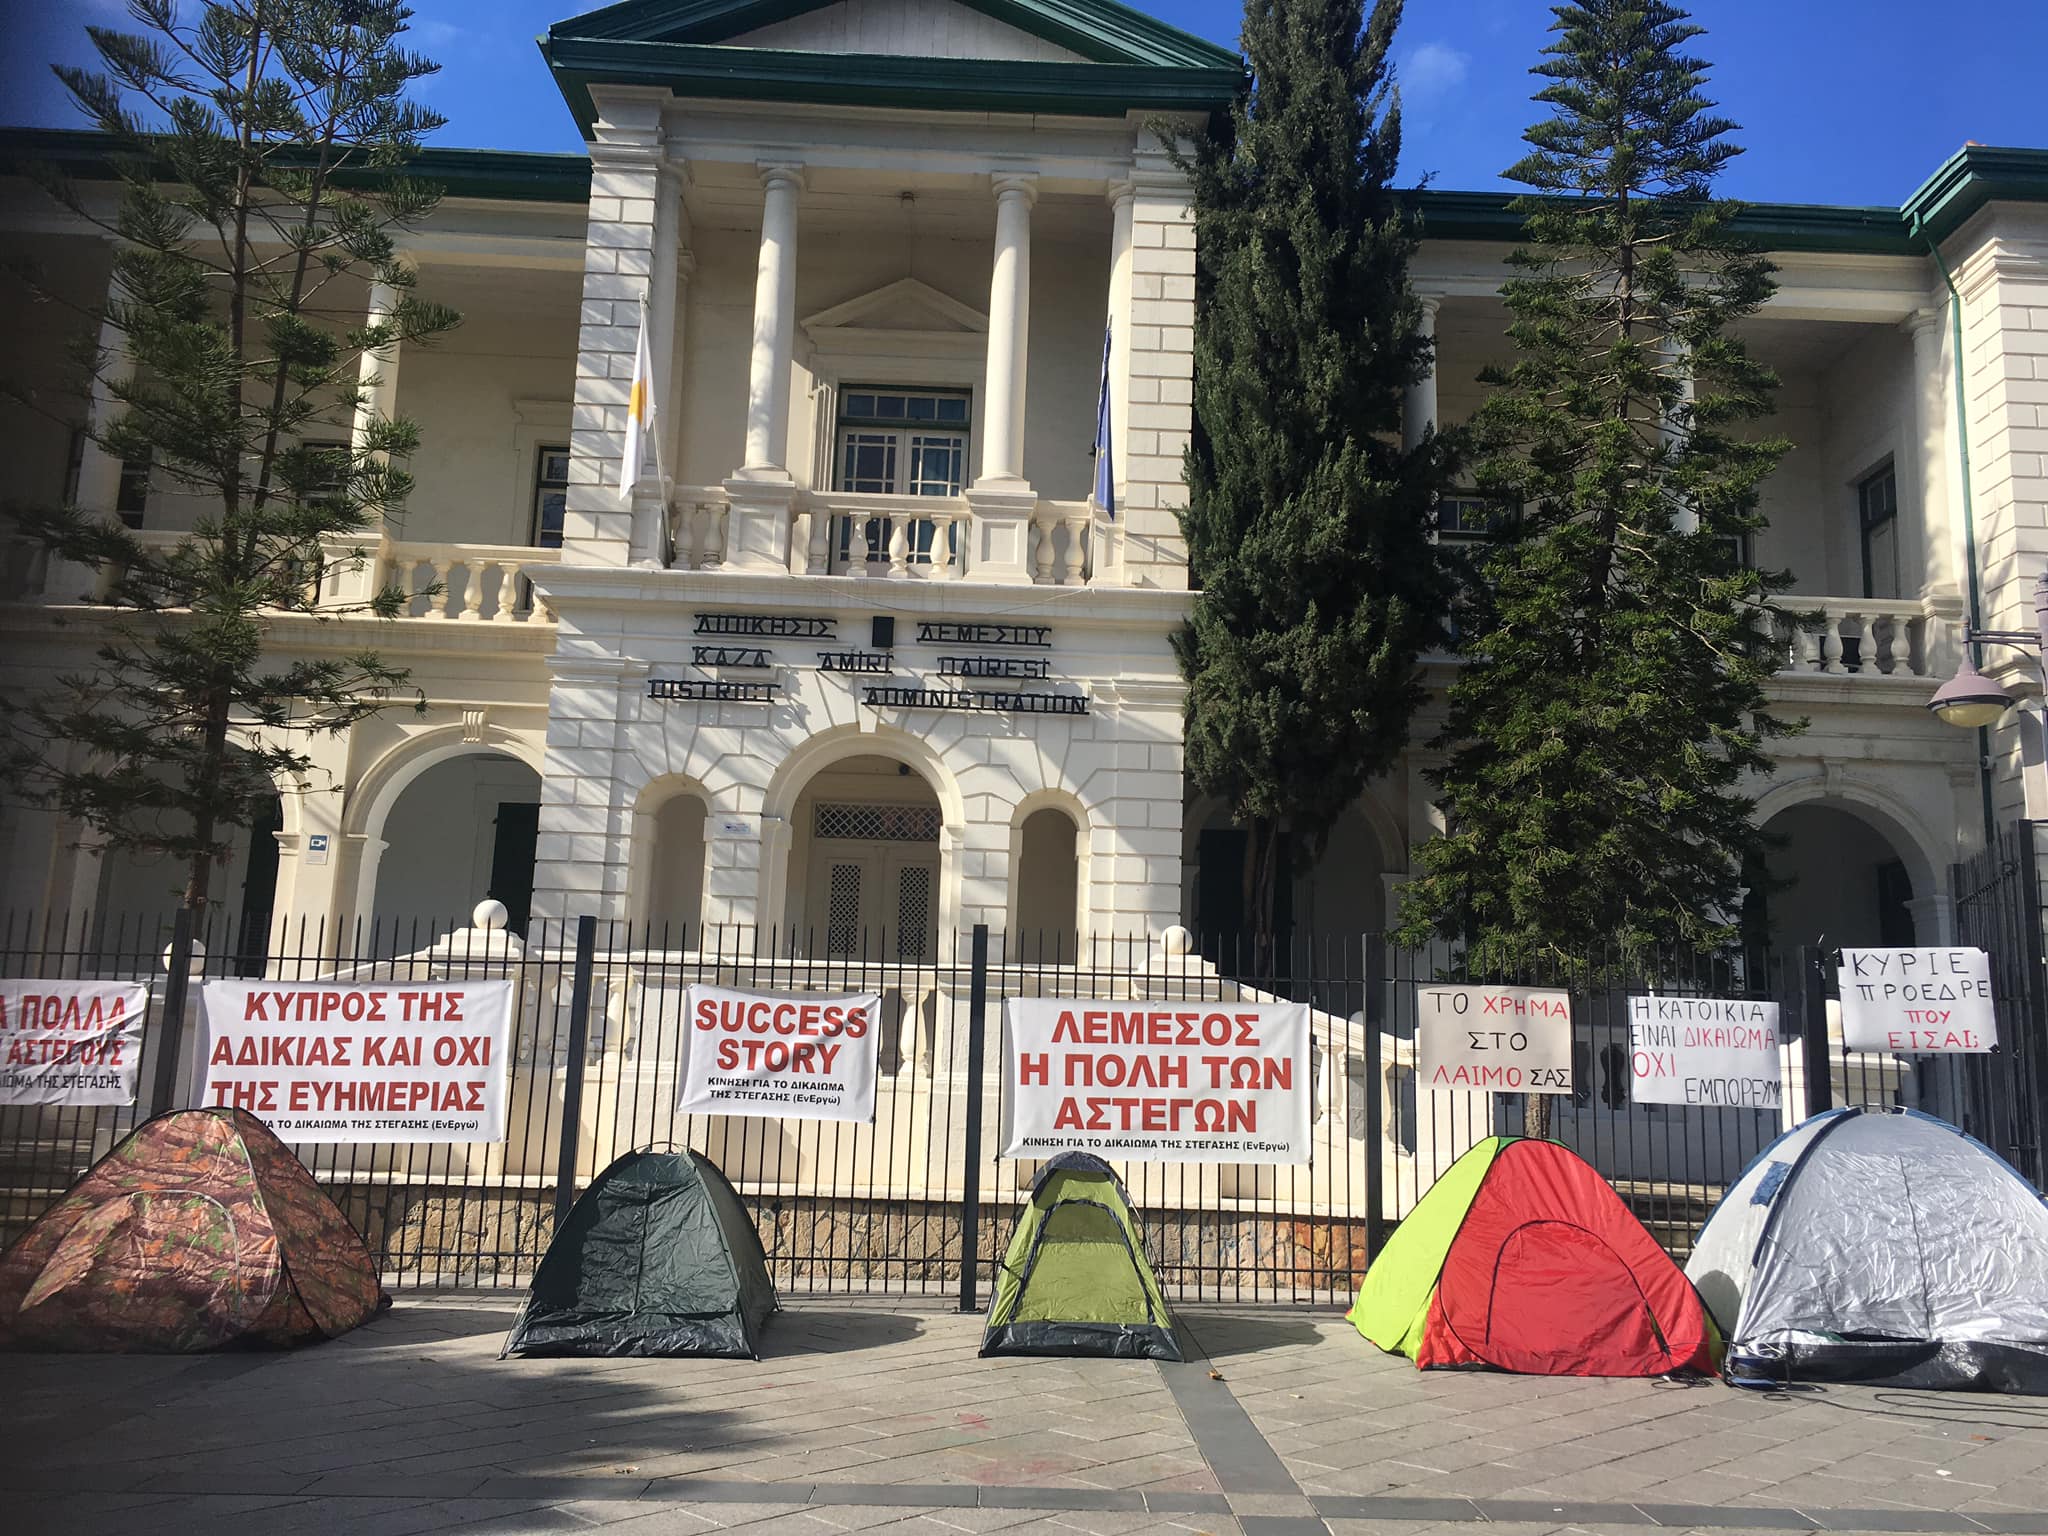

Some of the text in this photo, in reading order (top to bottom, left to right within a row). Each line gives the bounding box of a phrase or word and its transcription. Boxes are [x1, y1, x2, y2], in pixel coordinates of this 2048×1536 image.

[691, 646, 772, 668] KAZA
[647, 679, 1090, 715] DISTRICT ADMINISTRATION
[1852, 952, 1970, 976] ΚΥΡΙΕ
[1856, 980, 1990, 1001] ΠΡΟΕΔΡΕ
[20, 995, 126, 1031] ΠΟΛΛΑ
[244, 991, 464, 1022] ΚΥΠΡΟΣ ΤΗΣ
[695, 999, 867, 1038] SUCCESS
[1427, 992, 1568, 1020] ΤΟ ΧΡΗΜΑ
[1635, 998, 1765, 1022] Η ΚΑΤΟΙΚΙΑ
[1904, 1010, 1951, 1024] ΠΟΥ
[1051, 1011, 1260, 1046] ΛΕΜΕΣΟΣ
[1468, 1031, 1527, 1051] ΣΤΟ
[1630, 1024, 1776, 1051] ΕΙΝΑΙ ΔΙΚΑΙΩΜΑ
[1888, 1030, 1979, 1049] ΕΙΣΑΙ;
[7, 1039, 126, 1066] ΑΣΤΕΓΟΥΣ
[210, 1036, 491, 1067] ΑΔΙΚΙΑΣ ΚΑΙ ΟΧΙ
[717, 1038, 841, 1075] STORY
[1020, 1053, 1292, 1090] Η ΠΟΛΗ ΤΩΝ
[1433, 1064, 1572, 1088] ΛΑΙΜΟ ΣΑΣ
[1632, 1052, 1677, 1077] ΟΧΙ
[37, 1075, 59, 1089] ΤΗΣ
[61, 1075, 122, 1089] ΣΤΕΓΑΣΗΣ
[708, 1077, 845, 1092] ΚΙΝΗΣΗ ΓΙΑ ΤΟ ΔΙΚΑΙΩΜΑ
[211, 1081, 486, 1112] ΤΗΣ ΕΥΗΜΕΡΙΑΣ
[710, 1090, 731, 1099] ΤΗΣ
[734, 1091, 790, 1102] ΣΤΕΓΑΣΗΣ
[277, 1120, 292, 1129] ΤΟ
[294, 1120, 348, 1129] ΔΙΚΑΙΩΜΑ
[351, 1120, 372, 1129] ΤΗΣ
[375, 1120, 429, 1129] ΣΤΕΓΑΣΗΣ
[1053, 1097, 1257, 1133] ΑΣΤΕΓΩΝ
[1022, 1137, 1063, 1147] ΚΙΝΗΣΗ
[1066, 1138, 1084, 1147] ΓΙΑ
[1088, 1138, 1101, 1147] ΤΟ
[1104, 1138, 1158, 1149] ΔΙΚΑΙΩΜΑ
[1161, 1139, 1183, 1149] ΤΗΣ
[1185, 1140, 1240, 1150] ΣΤΕΓΑΣΗΣ
